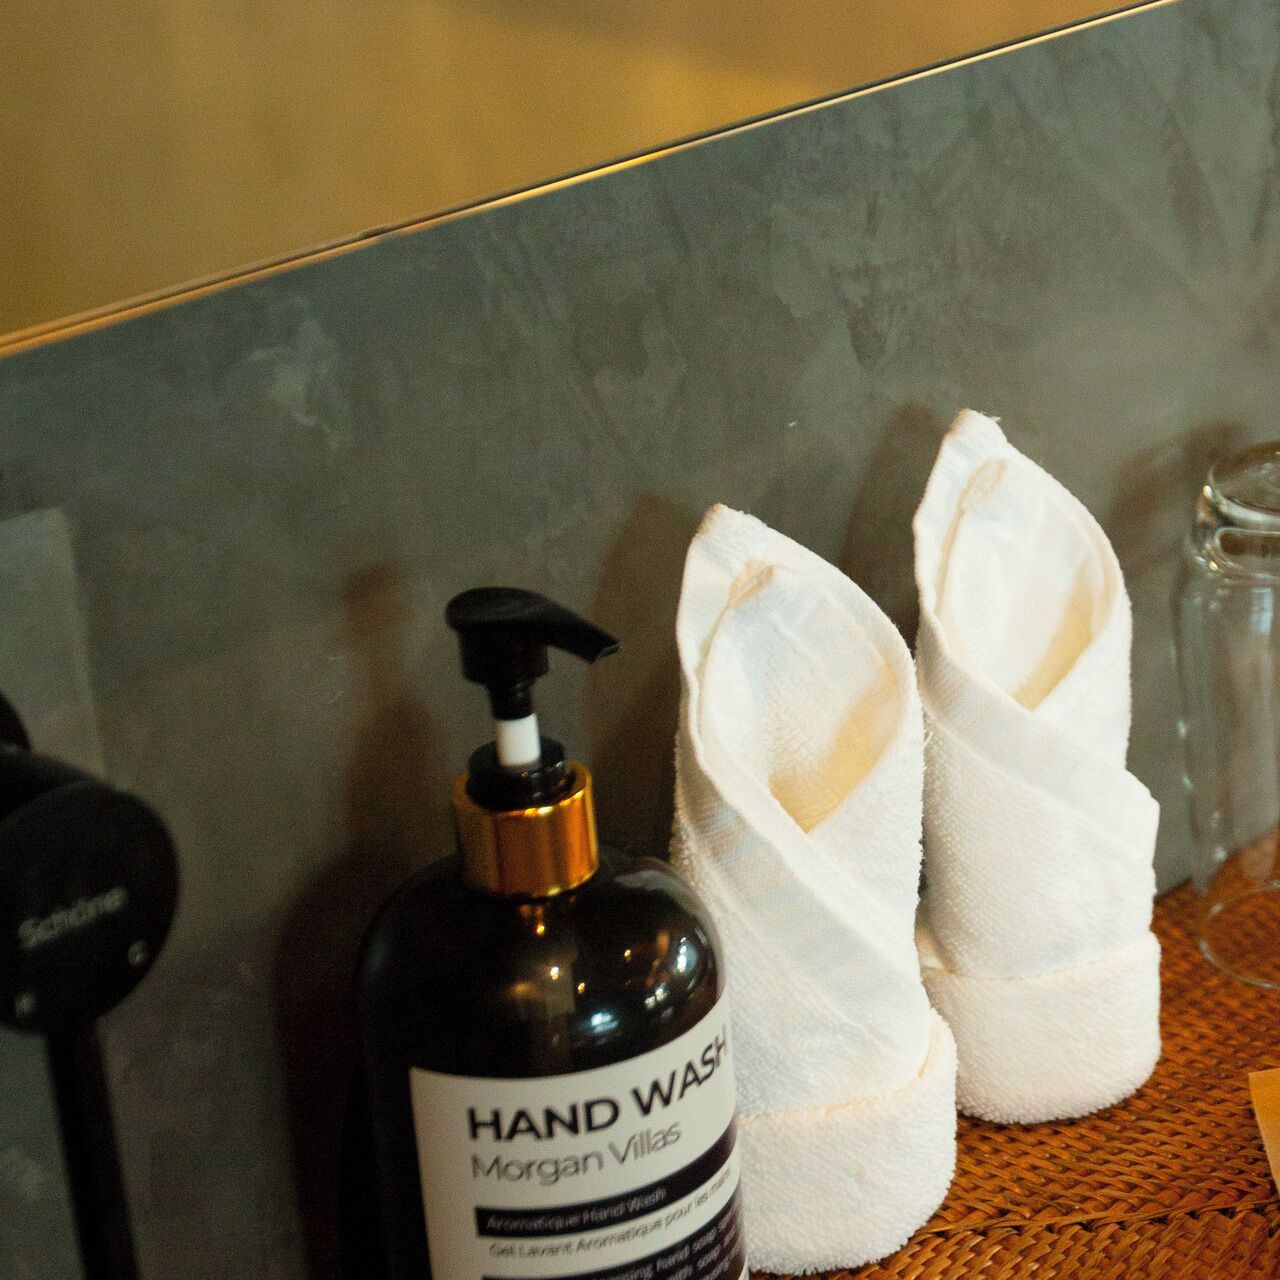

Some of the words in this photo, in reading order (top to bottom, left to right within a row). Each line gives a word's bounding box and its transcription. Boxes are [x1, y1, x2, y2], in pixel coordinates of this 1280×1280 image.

[467, 1096, 620, 1141] HAND
[632, 1024, 728, 1116] WASH
[470, 1150, 605, 1186] Morgan
[608, 1122, 682, 1164] Villas
[576, 1220, 662, 1253] Aromatique
[664, 1203, 693, 1230] pour
[582, 1201, 626, 1225] Hand
[626, 1187, 667, 1214] Wash
[656, 1244, 690, 1272] hand
[692, 1226, 718, 1254] soap
[697, 1243, 721, 1271] soap
